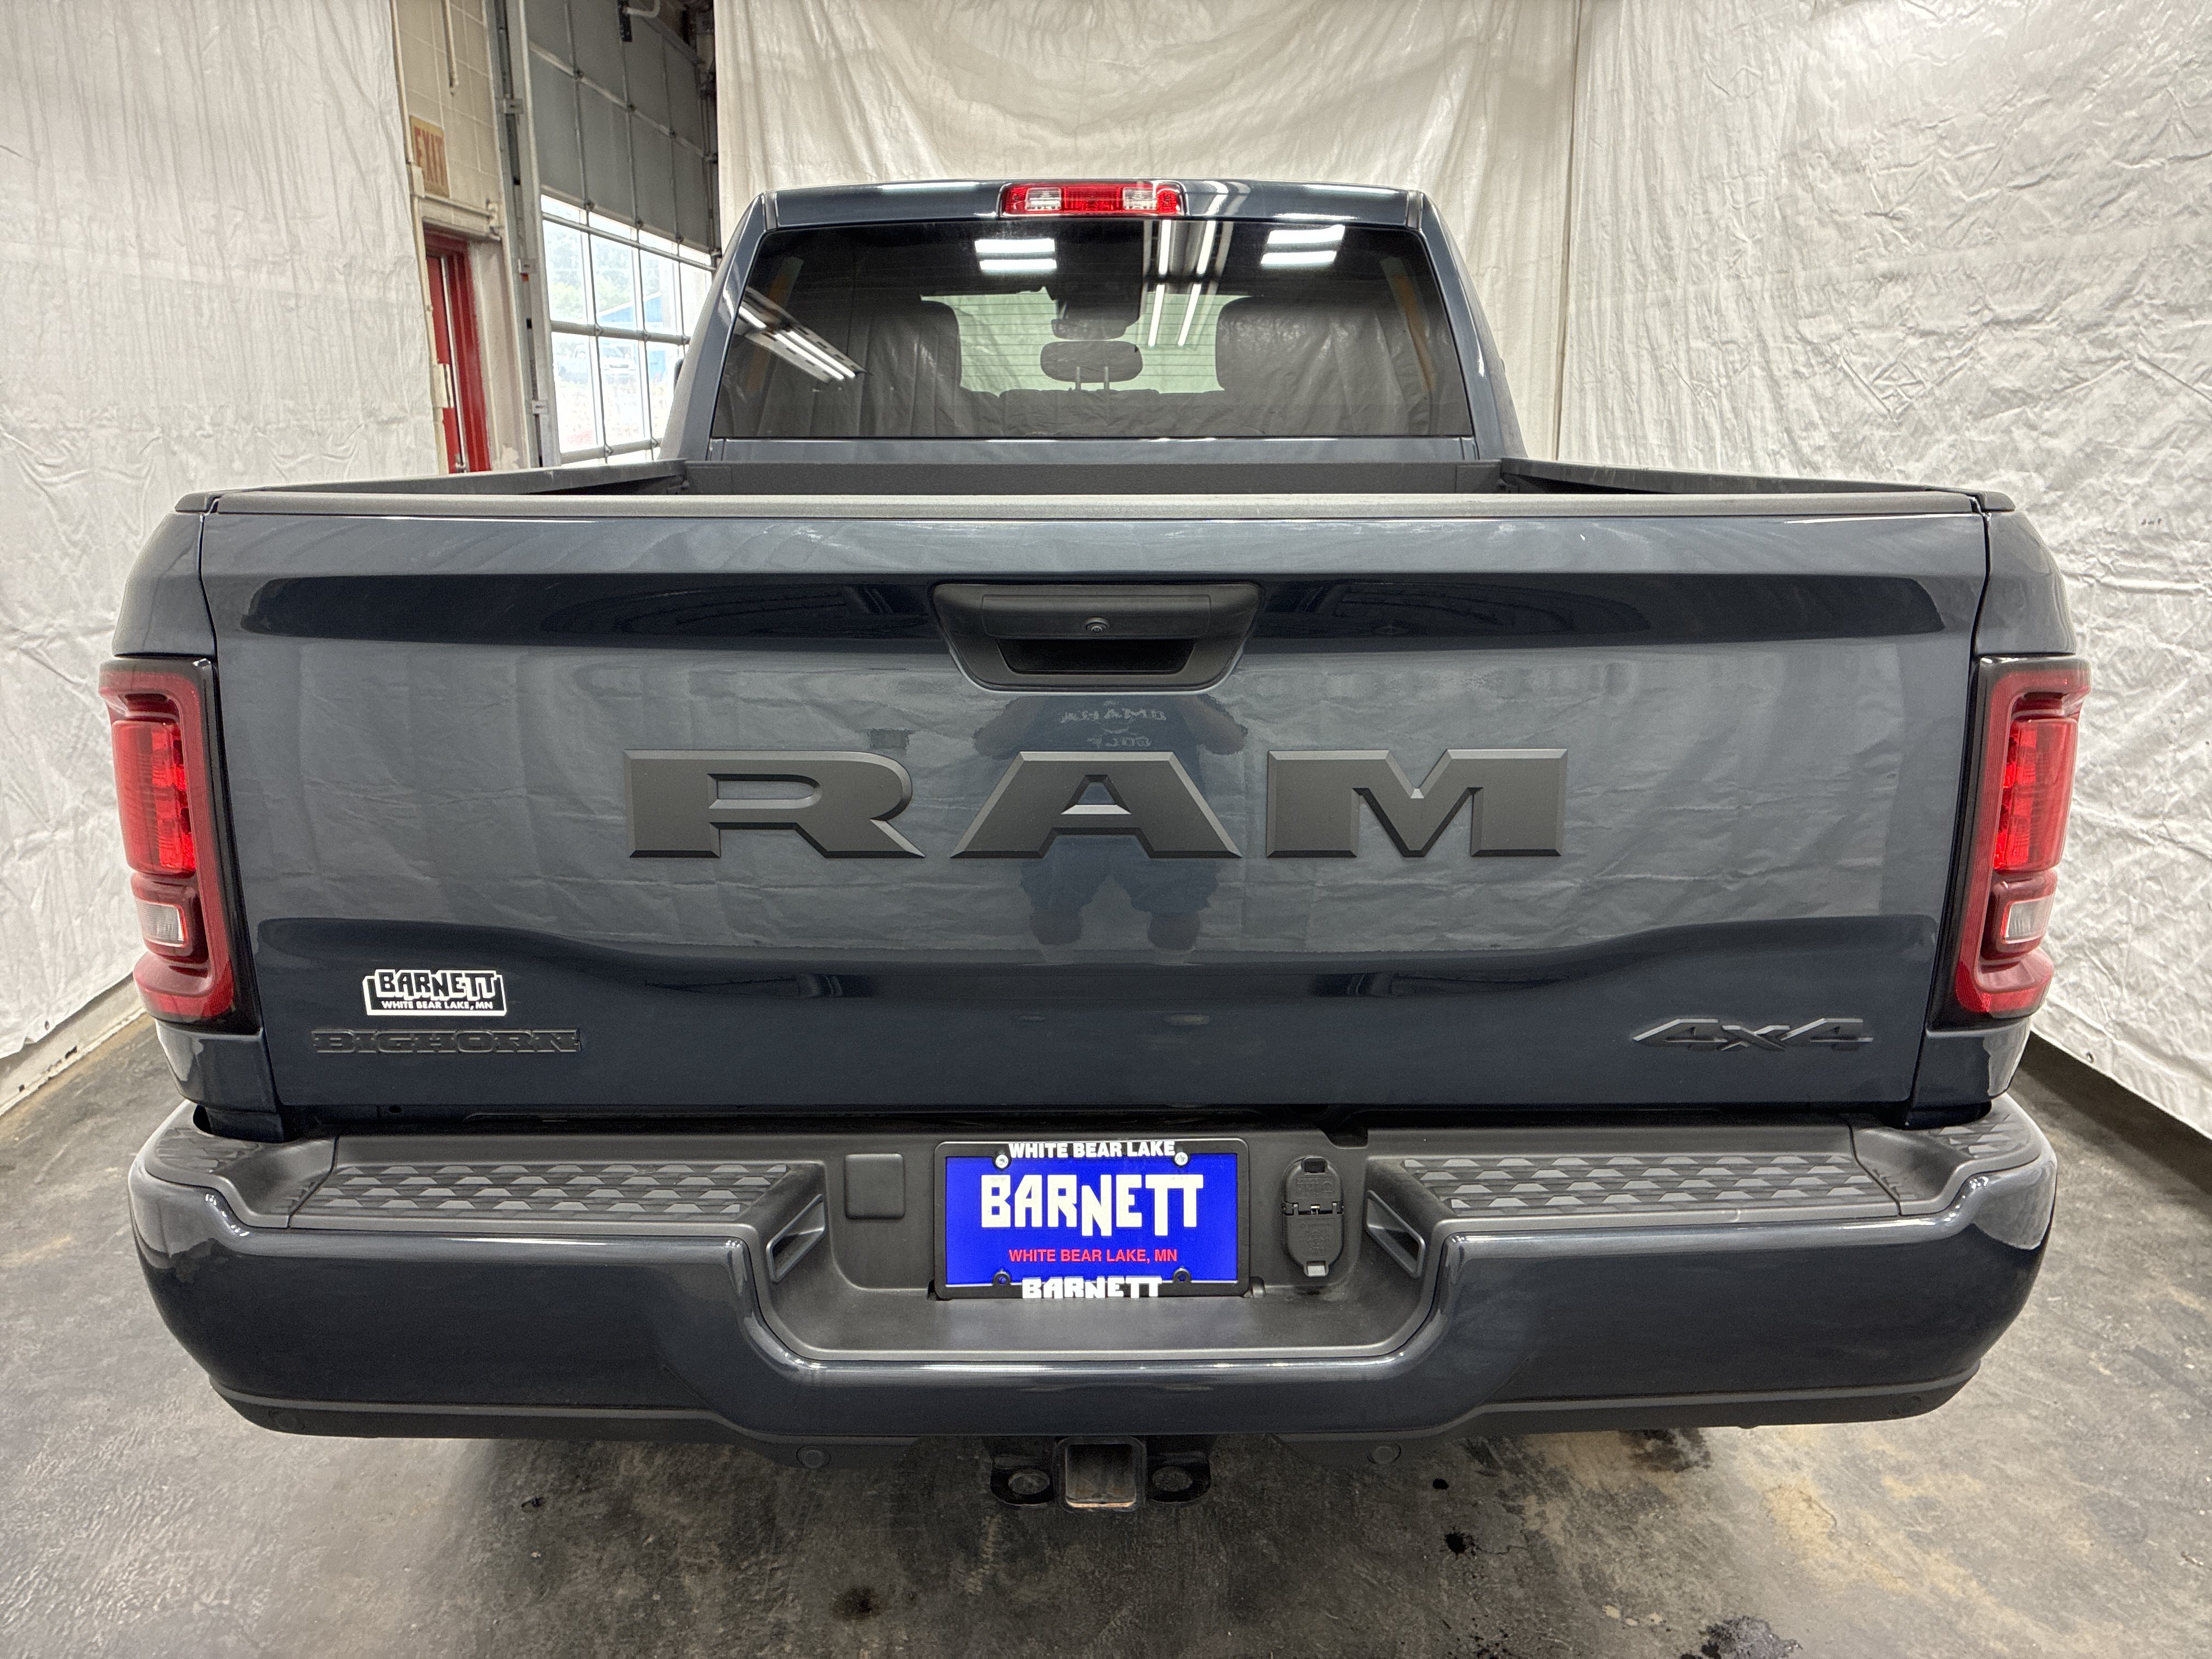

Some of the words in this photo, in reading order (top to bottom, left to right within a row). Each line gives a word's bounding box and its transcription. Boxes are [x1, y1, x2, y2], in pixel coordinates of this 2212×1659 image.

[621, 749, 1568, 858] RAM
[376, 970, 495, 999] BARNETT
[381, 1001, 414, 1009] WHITE
[416, 1001, 442, 1009] BEAR
[475, 1001, 493, 1009] MN
[1008, 1142, 1068, 1158] WHITE
[1073, 1142, 1122, 1158] BEAR
[1127, 1141, 1175, 1157] LAKE
[981, 1174, 1204, 1237] BARNETT
[1008, 1249, 1056, 1262] WHITE
[1060, 1249, 1102, 1262] BEAR
[1106, 1249, 1150, 1263] LAKE,
[1154, 1249, 1177, 1262] MN
[1022, 1276, 1163, 1299] BARNETT
